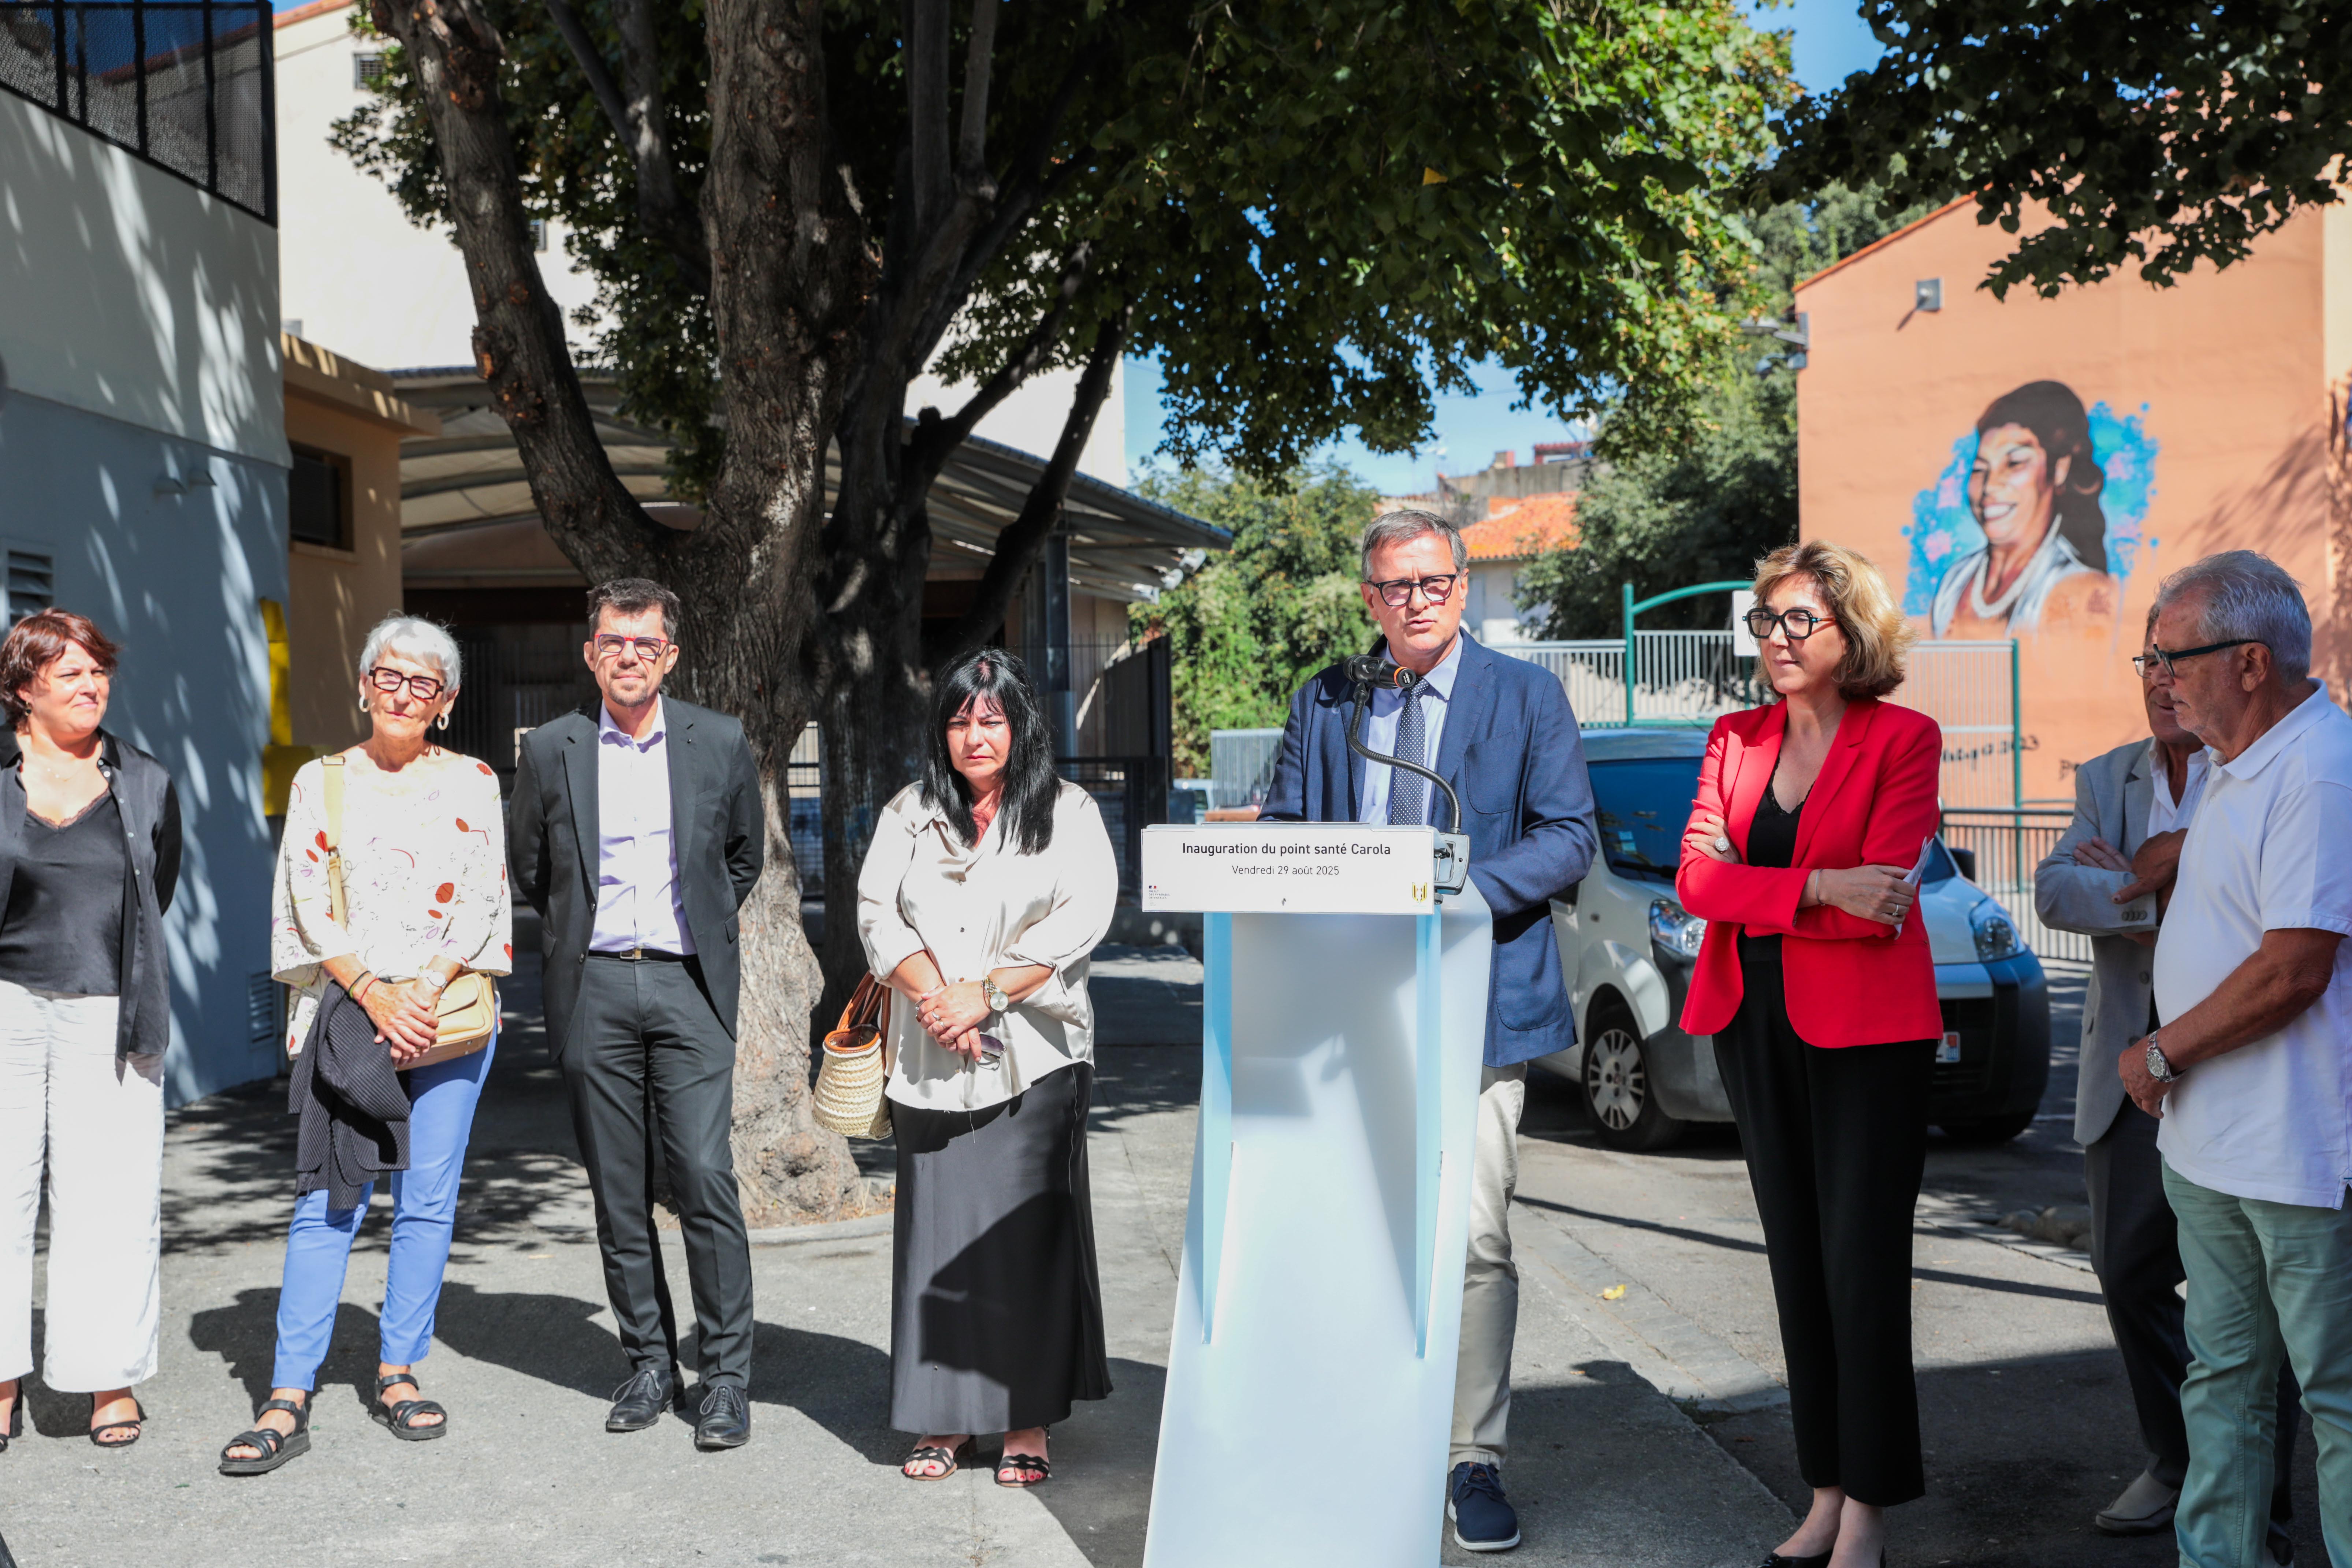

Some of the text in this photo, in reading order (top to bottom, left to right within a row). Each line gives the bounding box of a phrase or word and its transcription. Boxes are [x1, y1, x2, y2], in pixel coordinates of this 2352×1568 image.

[1183, 842, 1391, 857] Inauguration du point santé Carola
[1232, 865, 1339, 875] Vendredi 29 août 2025
